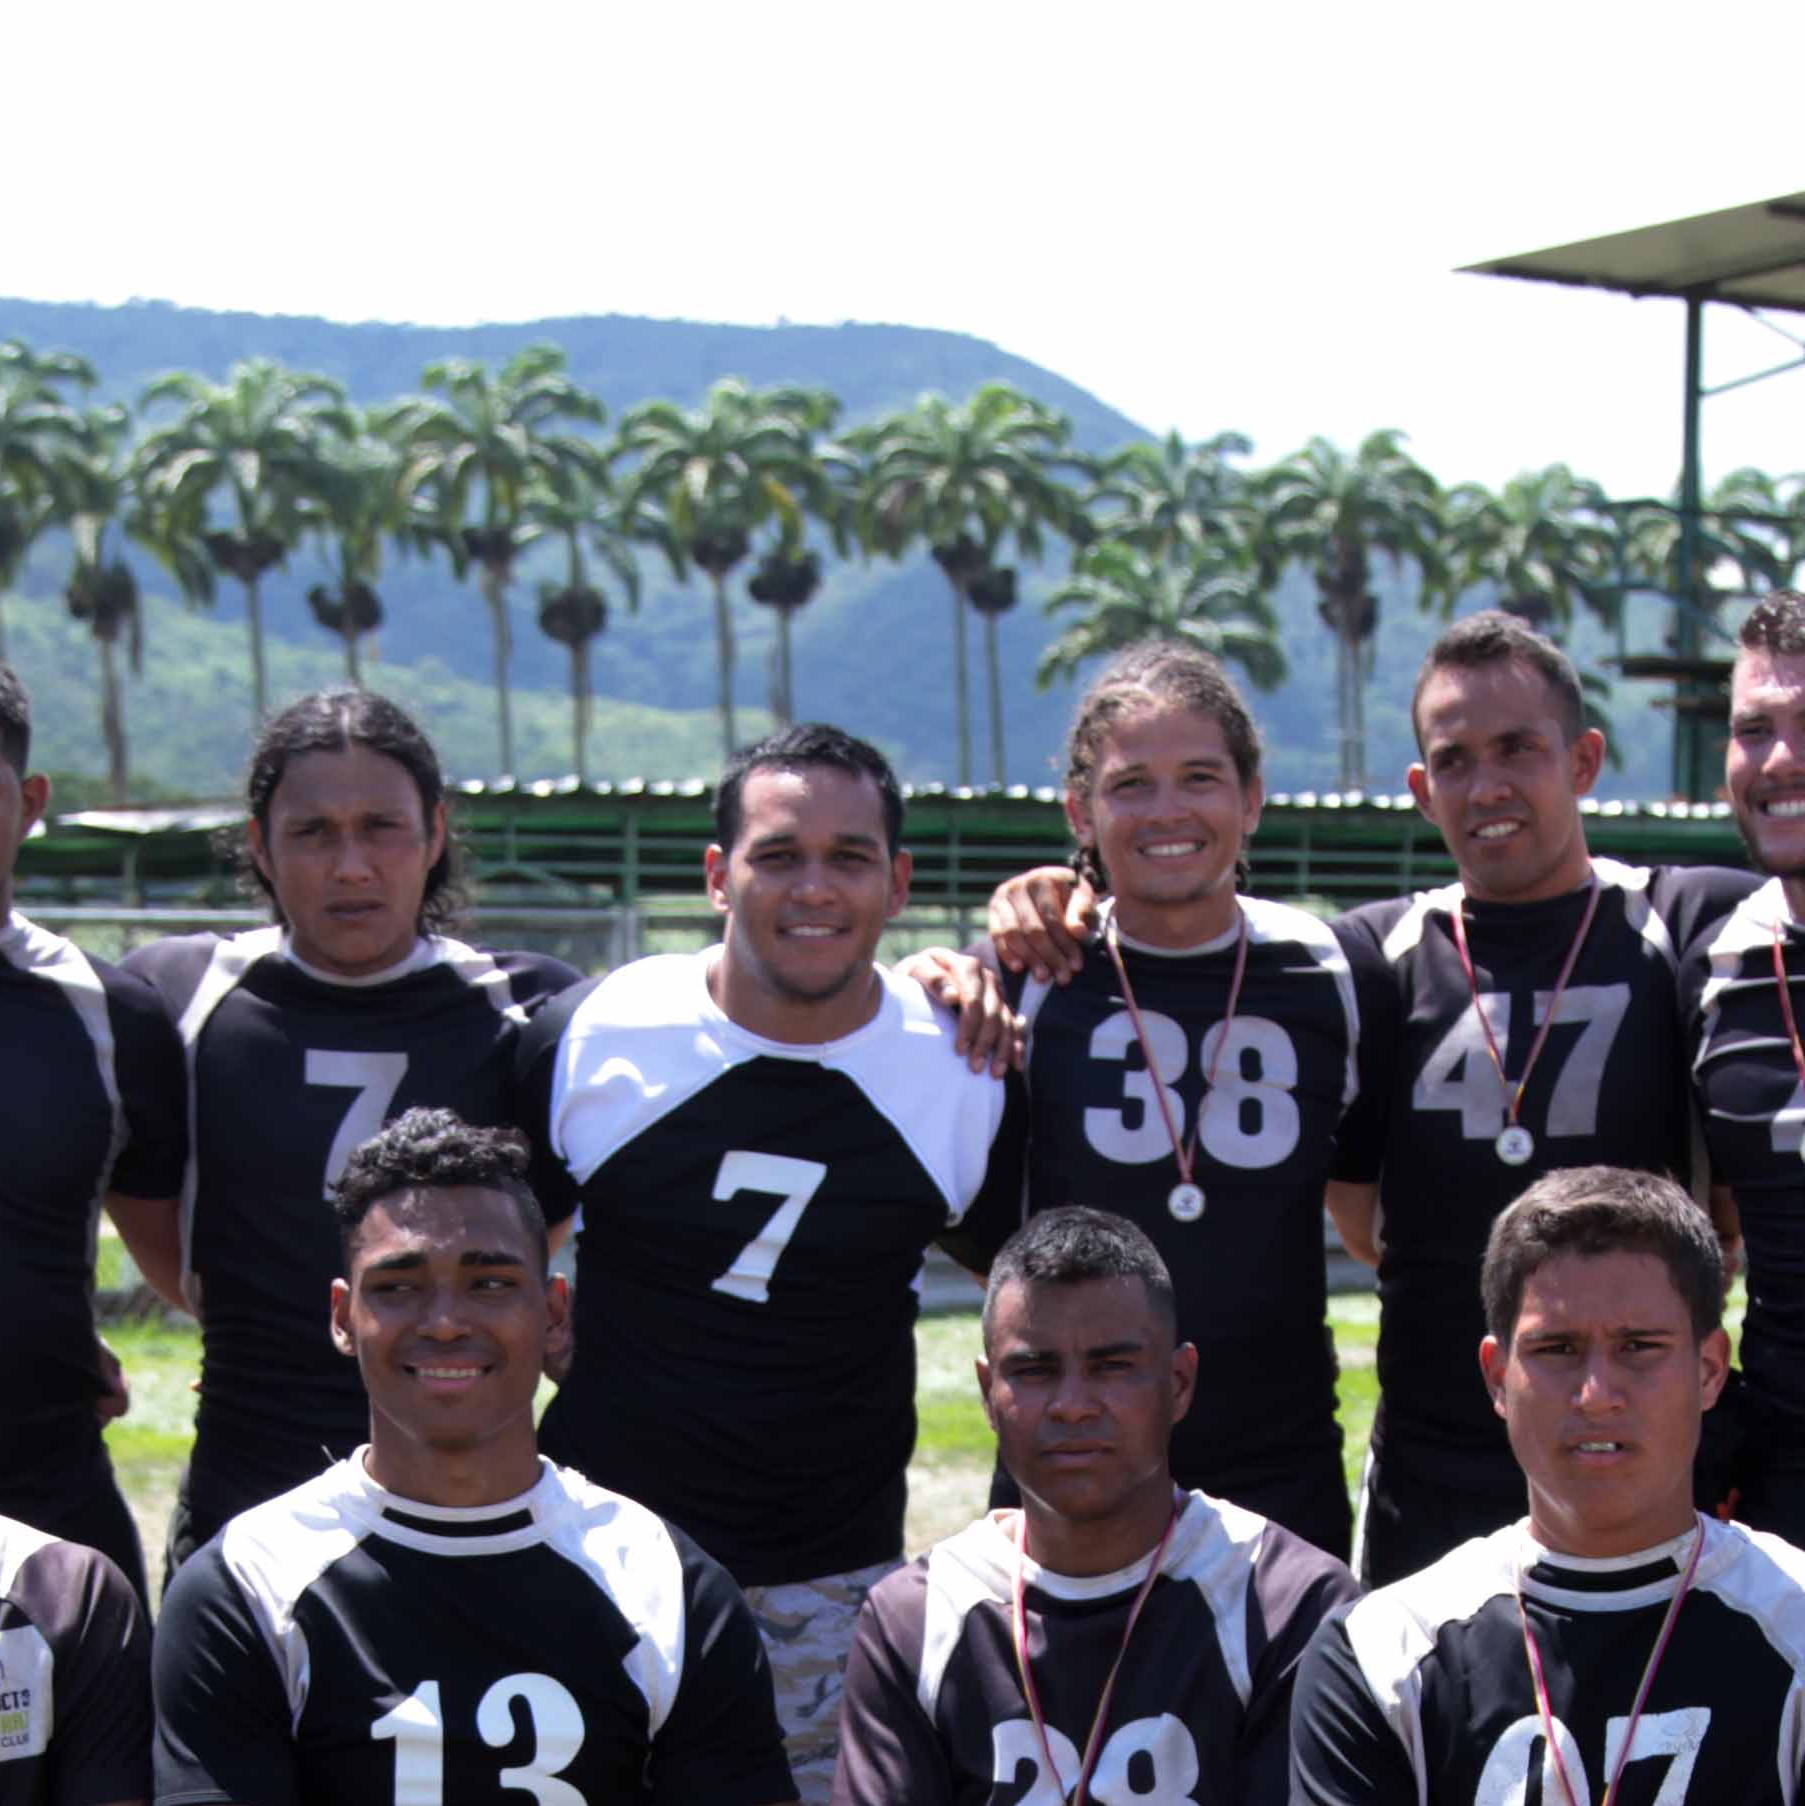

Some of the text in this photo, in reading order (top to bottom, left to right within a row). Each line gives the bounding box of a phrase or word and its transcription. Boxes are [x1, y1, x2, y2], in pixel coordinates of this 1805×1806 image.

[304, 1049, 409, 1201] 7
[1083, 1011, 1300, 1170] 38
[1412, 983, 1632, 1140] 47
[711, 1150, 828, 1303] 7
